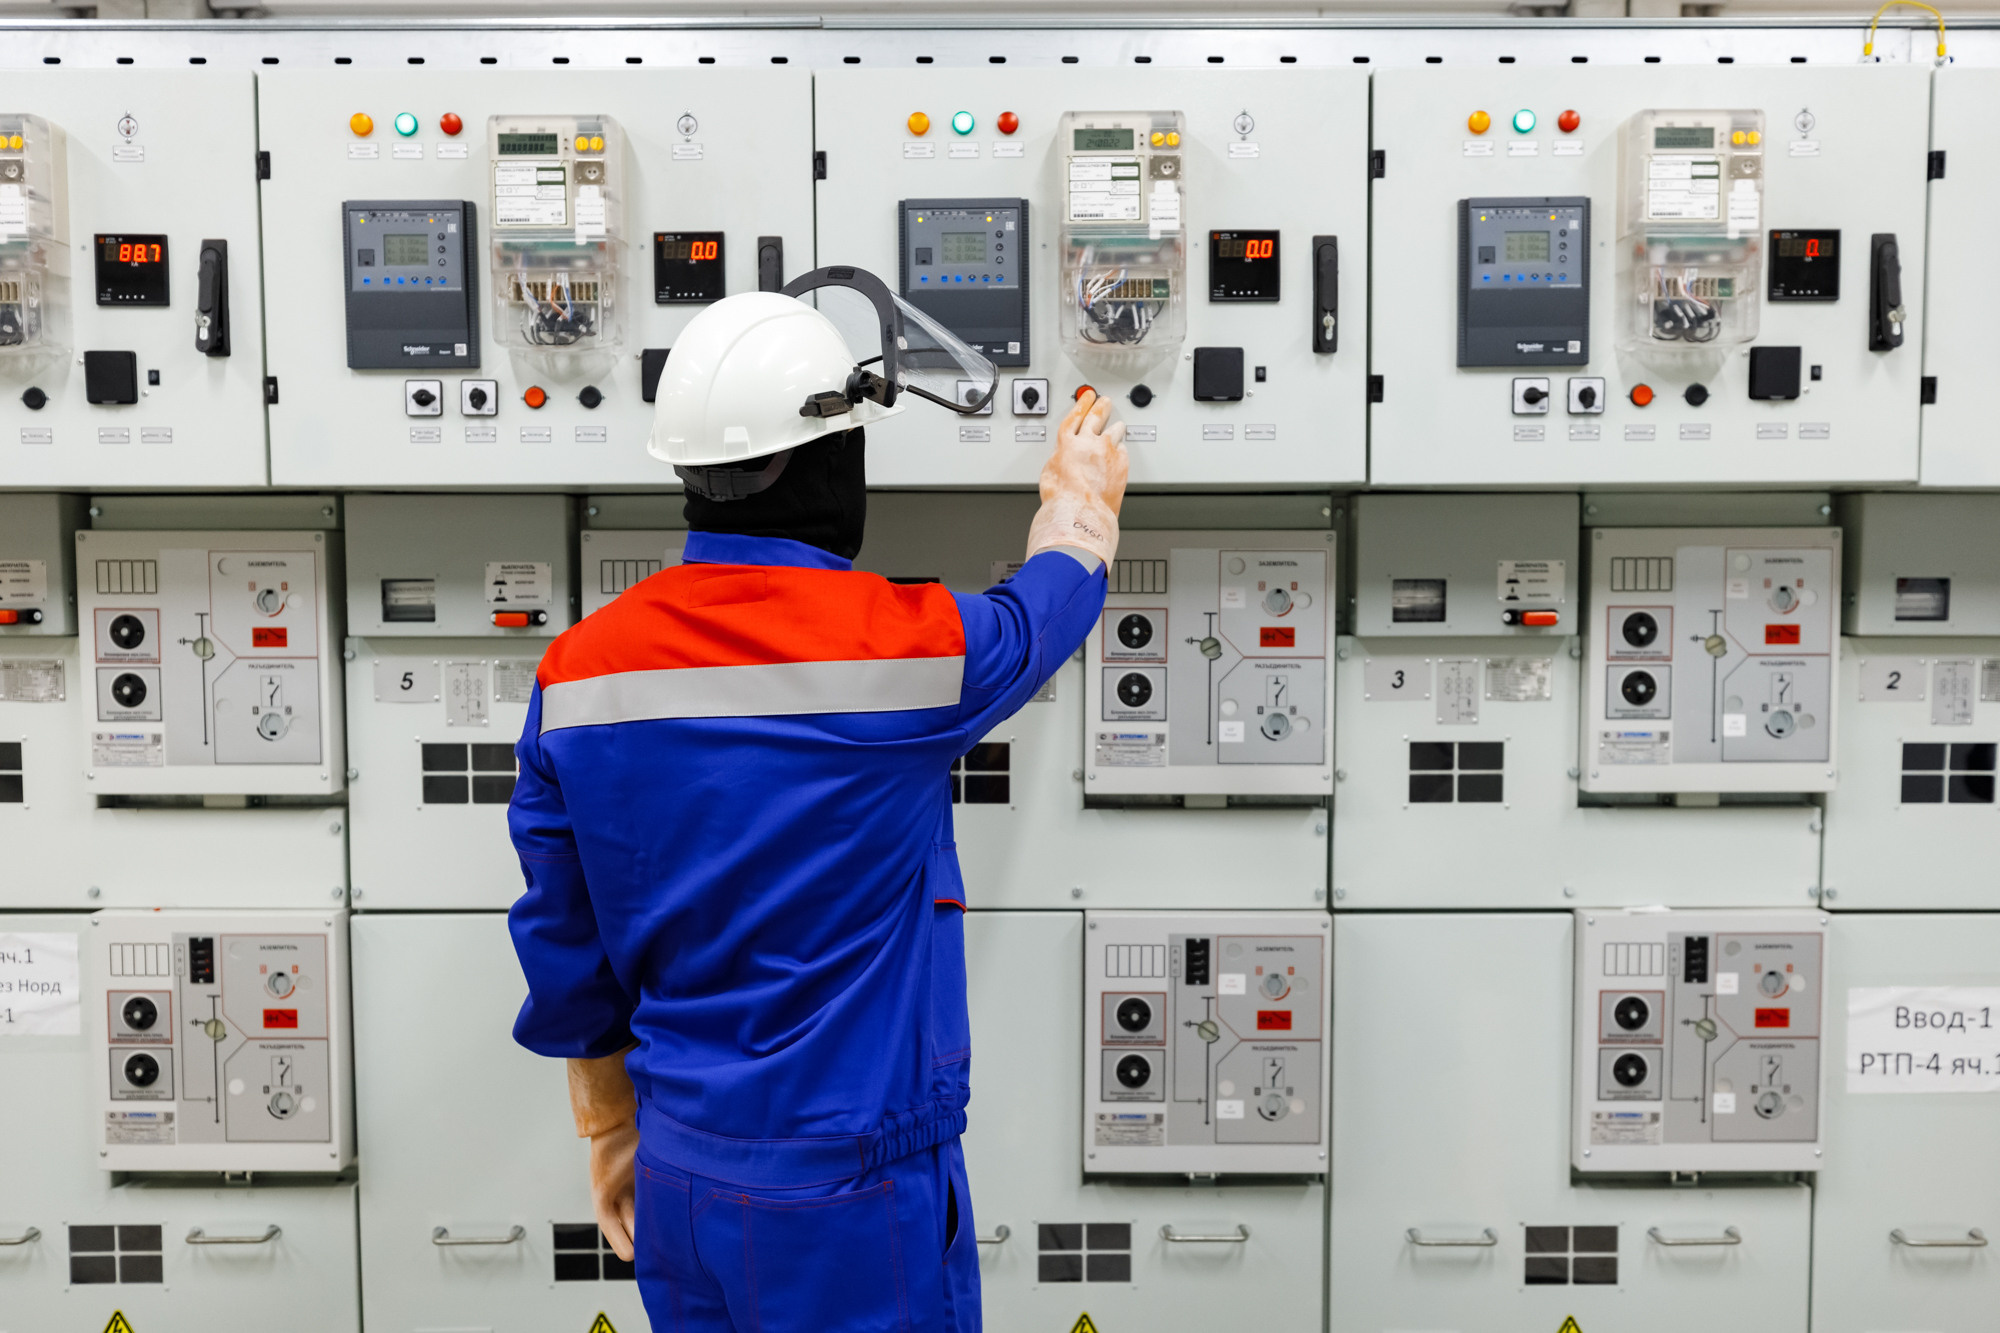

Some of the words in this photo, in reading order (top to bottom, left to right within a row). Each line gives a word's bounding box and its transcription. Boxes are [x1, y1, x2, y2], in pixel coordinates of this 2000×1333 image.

[119, 243, 162, 263] 88.7
[690, 241, 718, 260] 0.0
[1245, 239, 1274, 259] 0.0
[400, 672, 414, 691] 5
[1391, 670, 1405, 689] 3
[1886, 671, 1901, 690] 2
[18, 979, 61, 995] Норд
[1896, 1006, 1992, 1033] Ввод-1
[1861, 1052, 1941, 1075] РТП-4
